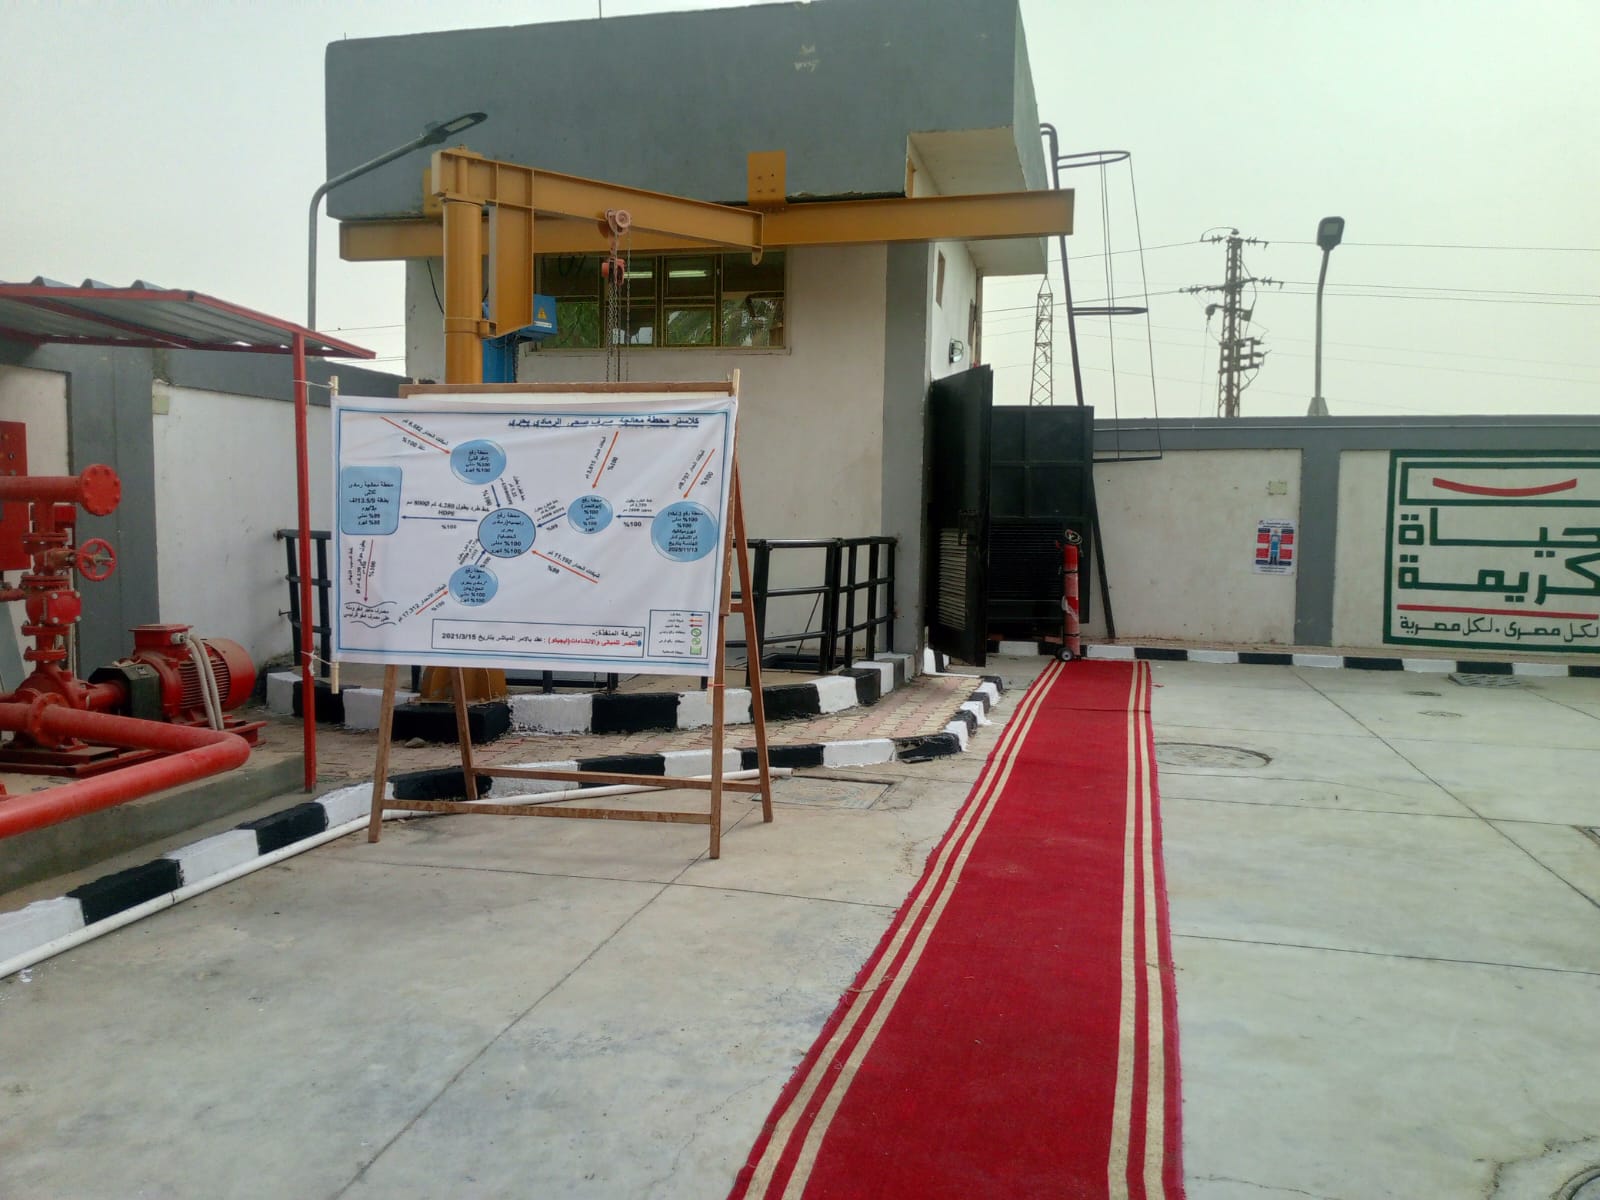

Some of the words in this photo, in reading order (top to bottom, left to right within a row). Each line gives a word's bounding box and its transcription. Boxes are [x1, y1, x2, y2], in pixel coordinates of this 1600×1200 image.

[648, 414, 671, 426] محطة
[1400, 615, 1461, 636] مصرية
[1462, 616, 1493, 636] لكل
[1563, 622, 1600, 643] لكل
